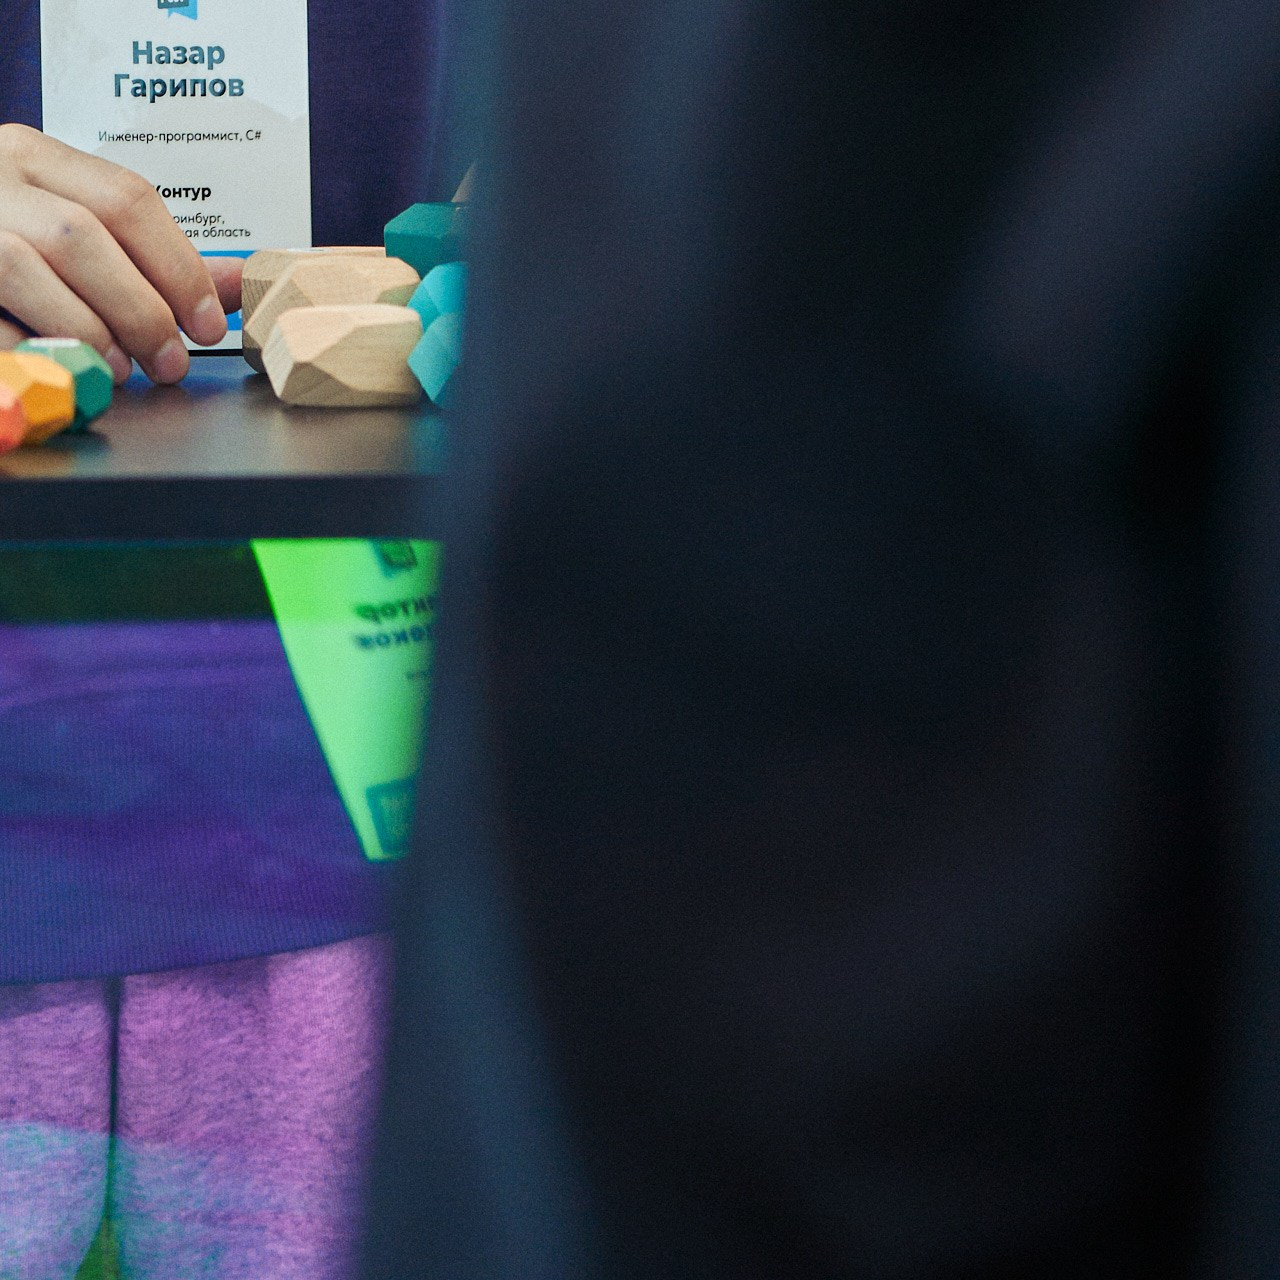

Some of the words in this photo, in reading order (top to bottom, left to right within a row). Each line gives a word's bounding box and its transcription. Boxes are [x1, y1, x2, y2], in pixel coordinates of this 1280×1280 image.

[132, 40, 226, 71] Назар
[113, 73, 246, 104] Гарипов
[98, 130, 243, 144] Инженер-программист,
[202, 226, 252, 238] область
